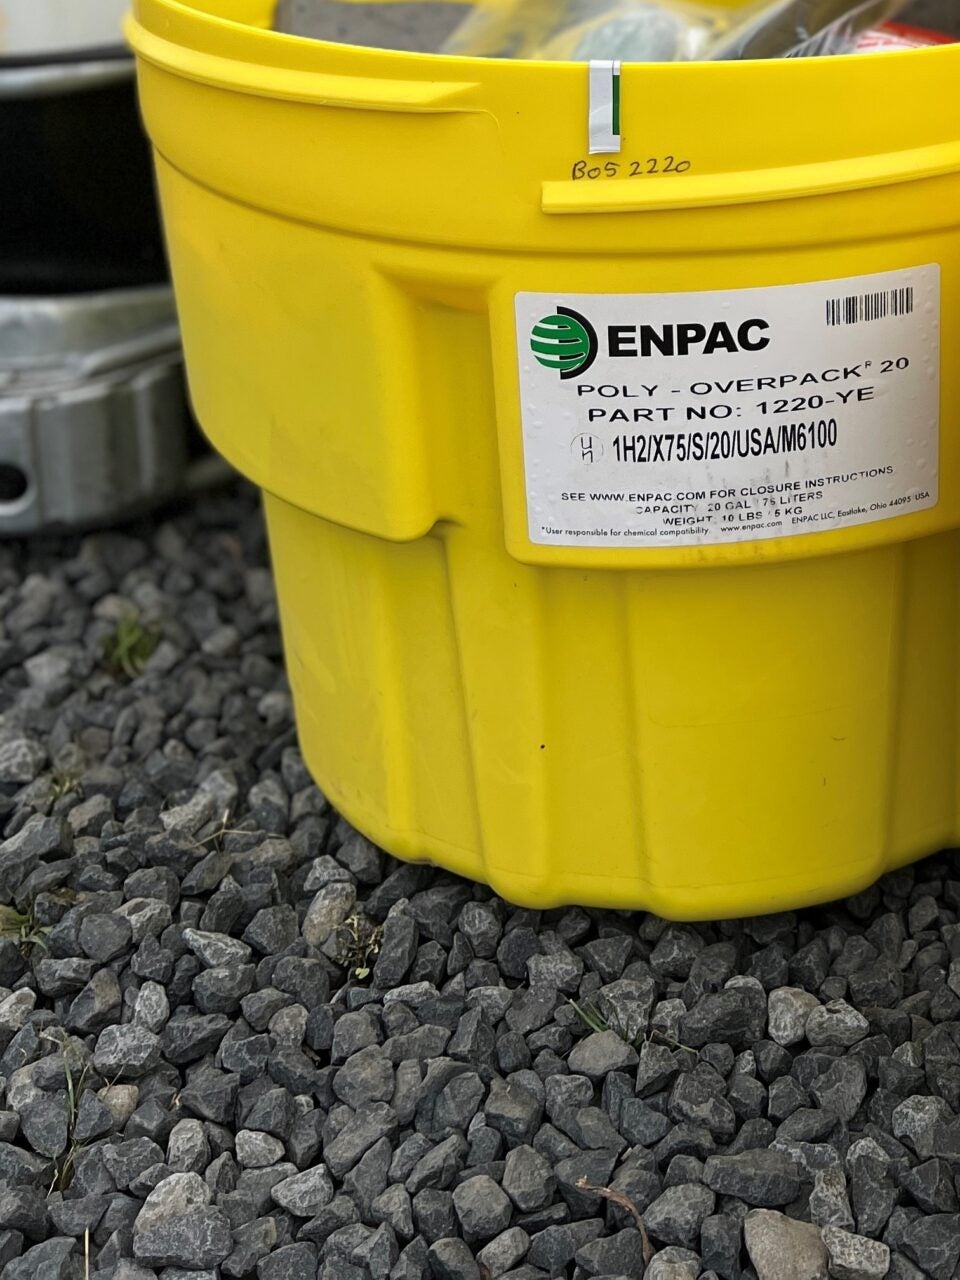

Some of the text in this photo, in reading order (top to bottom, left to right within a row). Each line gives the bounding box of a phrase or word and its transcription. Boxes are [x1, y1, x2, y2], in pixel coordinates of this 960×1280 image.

[629, 156, 691, 177] 2220
[608, 318, 770, 357] ENPAC
[577, 384, 658, 398] POLY
[880, 357, 910, 373] 20
[588, 386, 875, 422] PART NO: 1220-YE
[612, 418, 838, 463] 1H2/X75/S/20/USA/M6100
[561, 465, 894, 502] SEE WWW.ENPAC.COM FOR CLOSURE INSTRUCTIONS
[725, 500, 751, 511] GAL
[780, 491, 823, 505] LITERS
[738, 511, 763, 522] LBS
[785, 506, 803, 516] KG
[791, 513, 819, 525] ENPAC
[837, 506, 868, 518] Eastlake,
[869, 502, 887, 511] Ohio
[888, 496, 912, 507] 44095
[915, 491, 930, 500] USA
[565, 527, 608, 537] responsible
[610, 528, 621, 536] for
[623, 528, 657, 536] chemical
[720, 520, 783, 532] www.enpac.com
